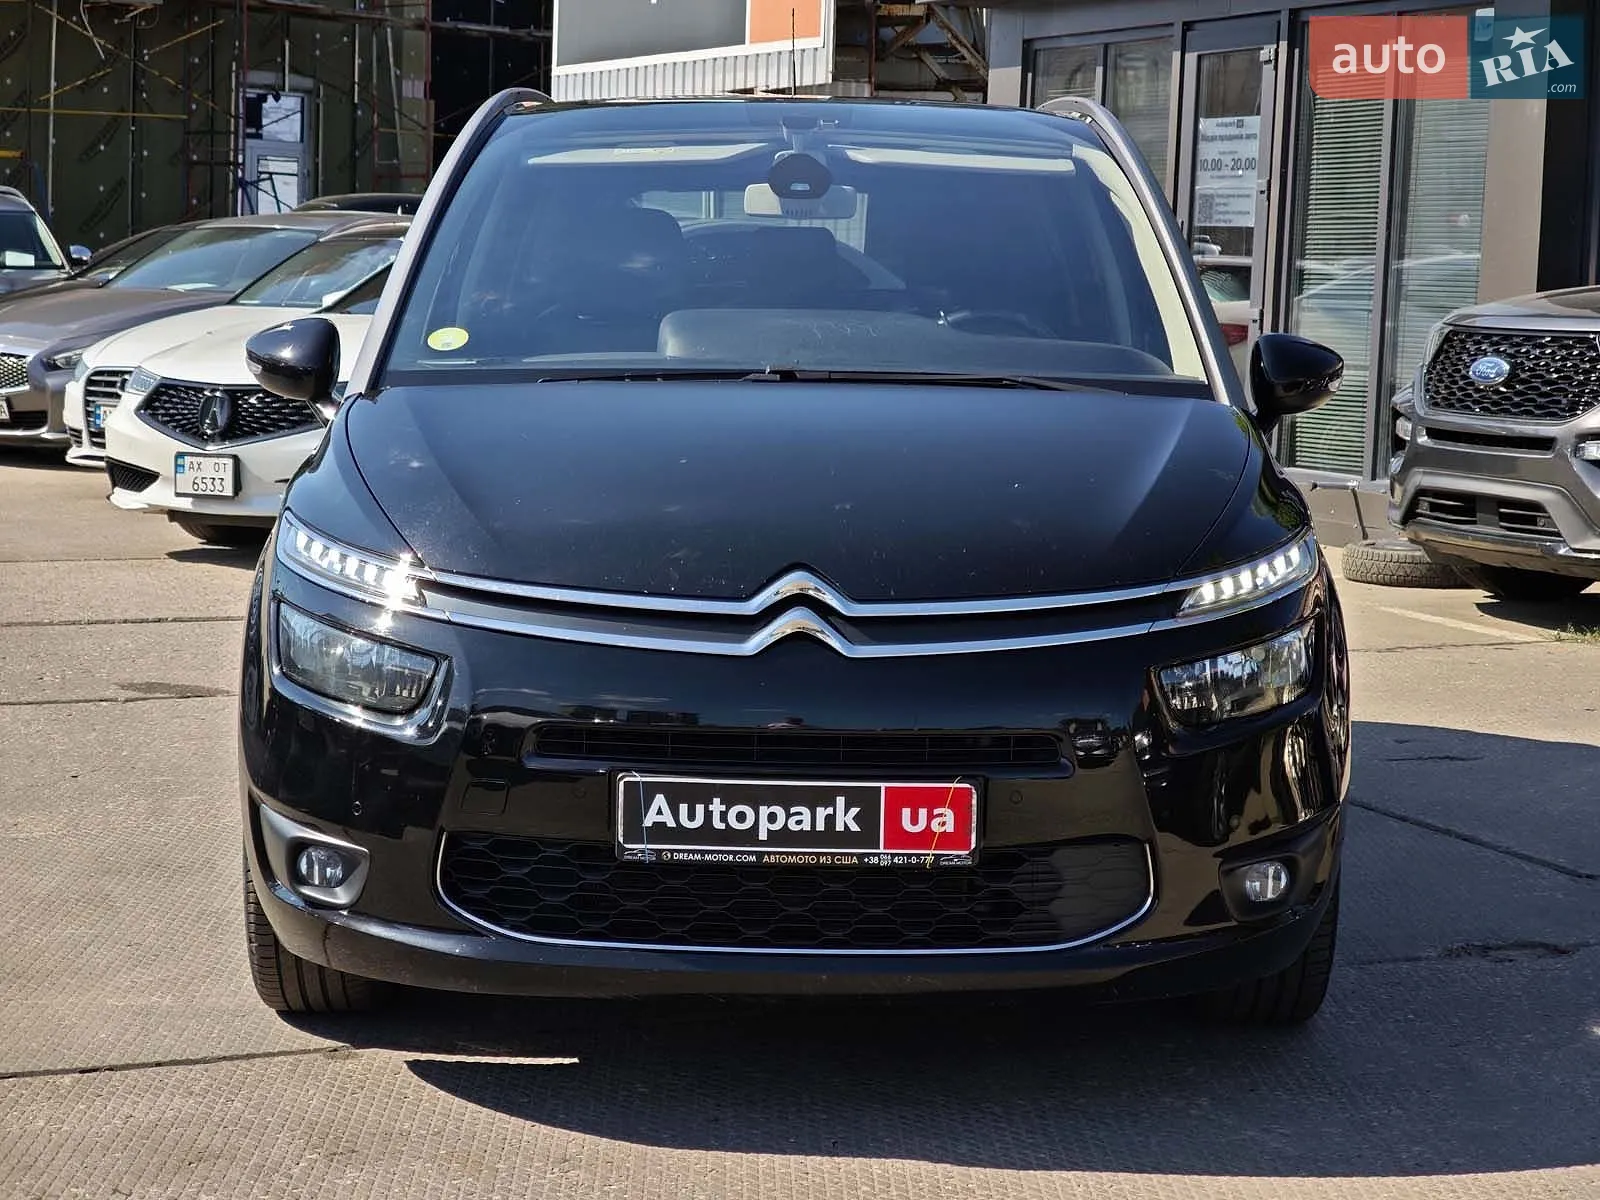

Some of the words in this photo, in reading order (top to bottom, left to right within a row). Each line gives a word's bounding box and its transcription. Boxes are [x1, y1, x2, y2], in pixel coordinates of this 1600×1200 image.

[188, 460, 203, 472] AX
[192, 476, 225, 493] 6533
[642, 793, 861, 840] Autopark
[901, 806, 955, 833] ua
[673, 852, 757, 863] DREAM-MOTOR.COM
[763, 854, 817, 864] АВТОМОТО
[820, 855, 832, 864] ИЗ
[834, 855, 859, 865] США
[863, 856, 879, 864] +38
